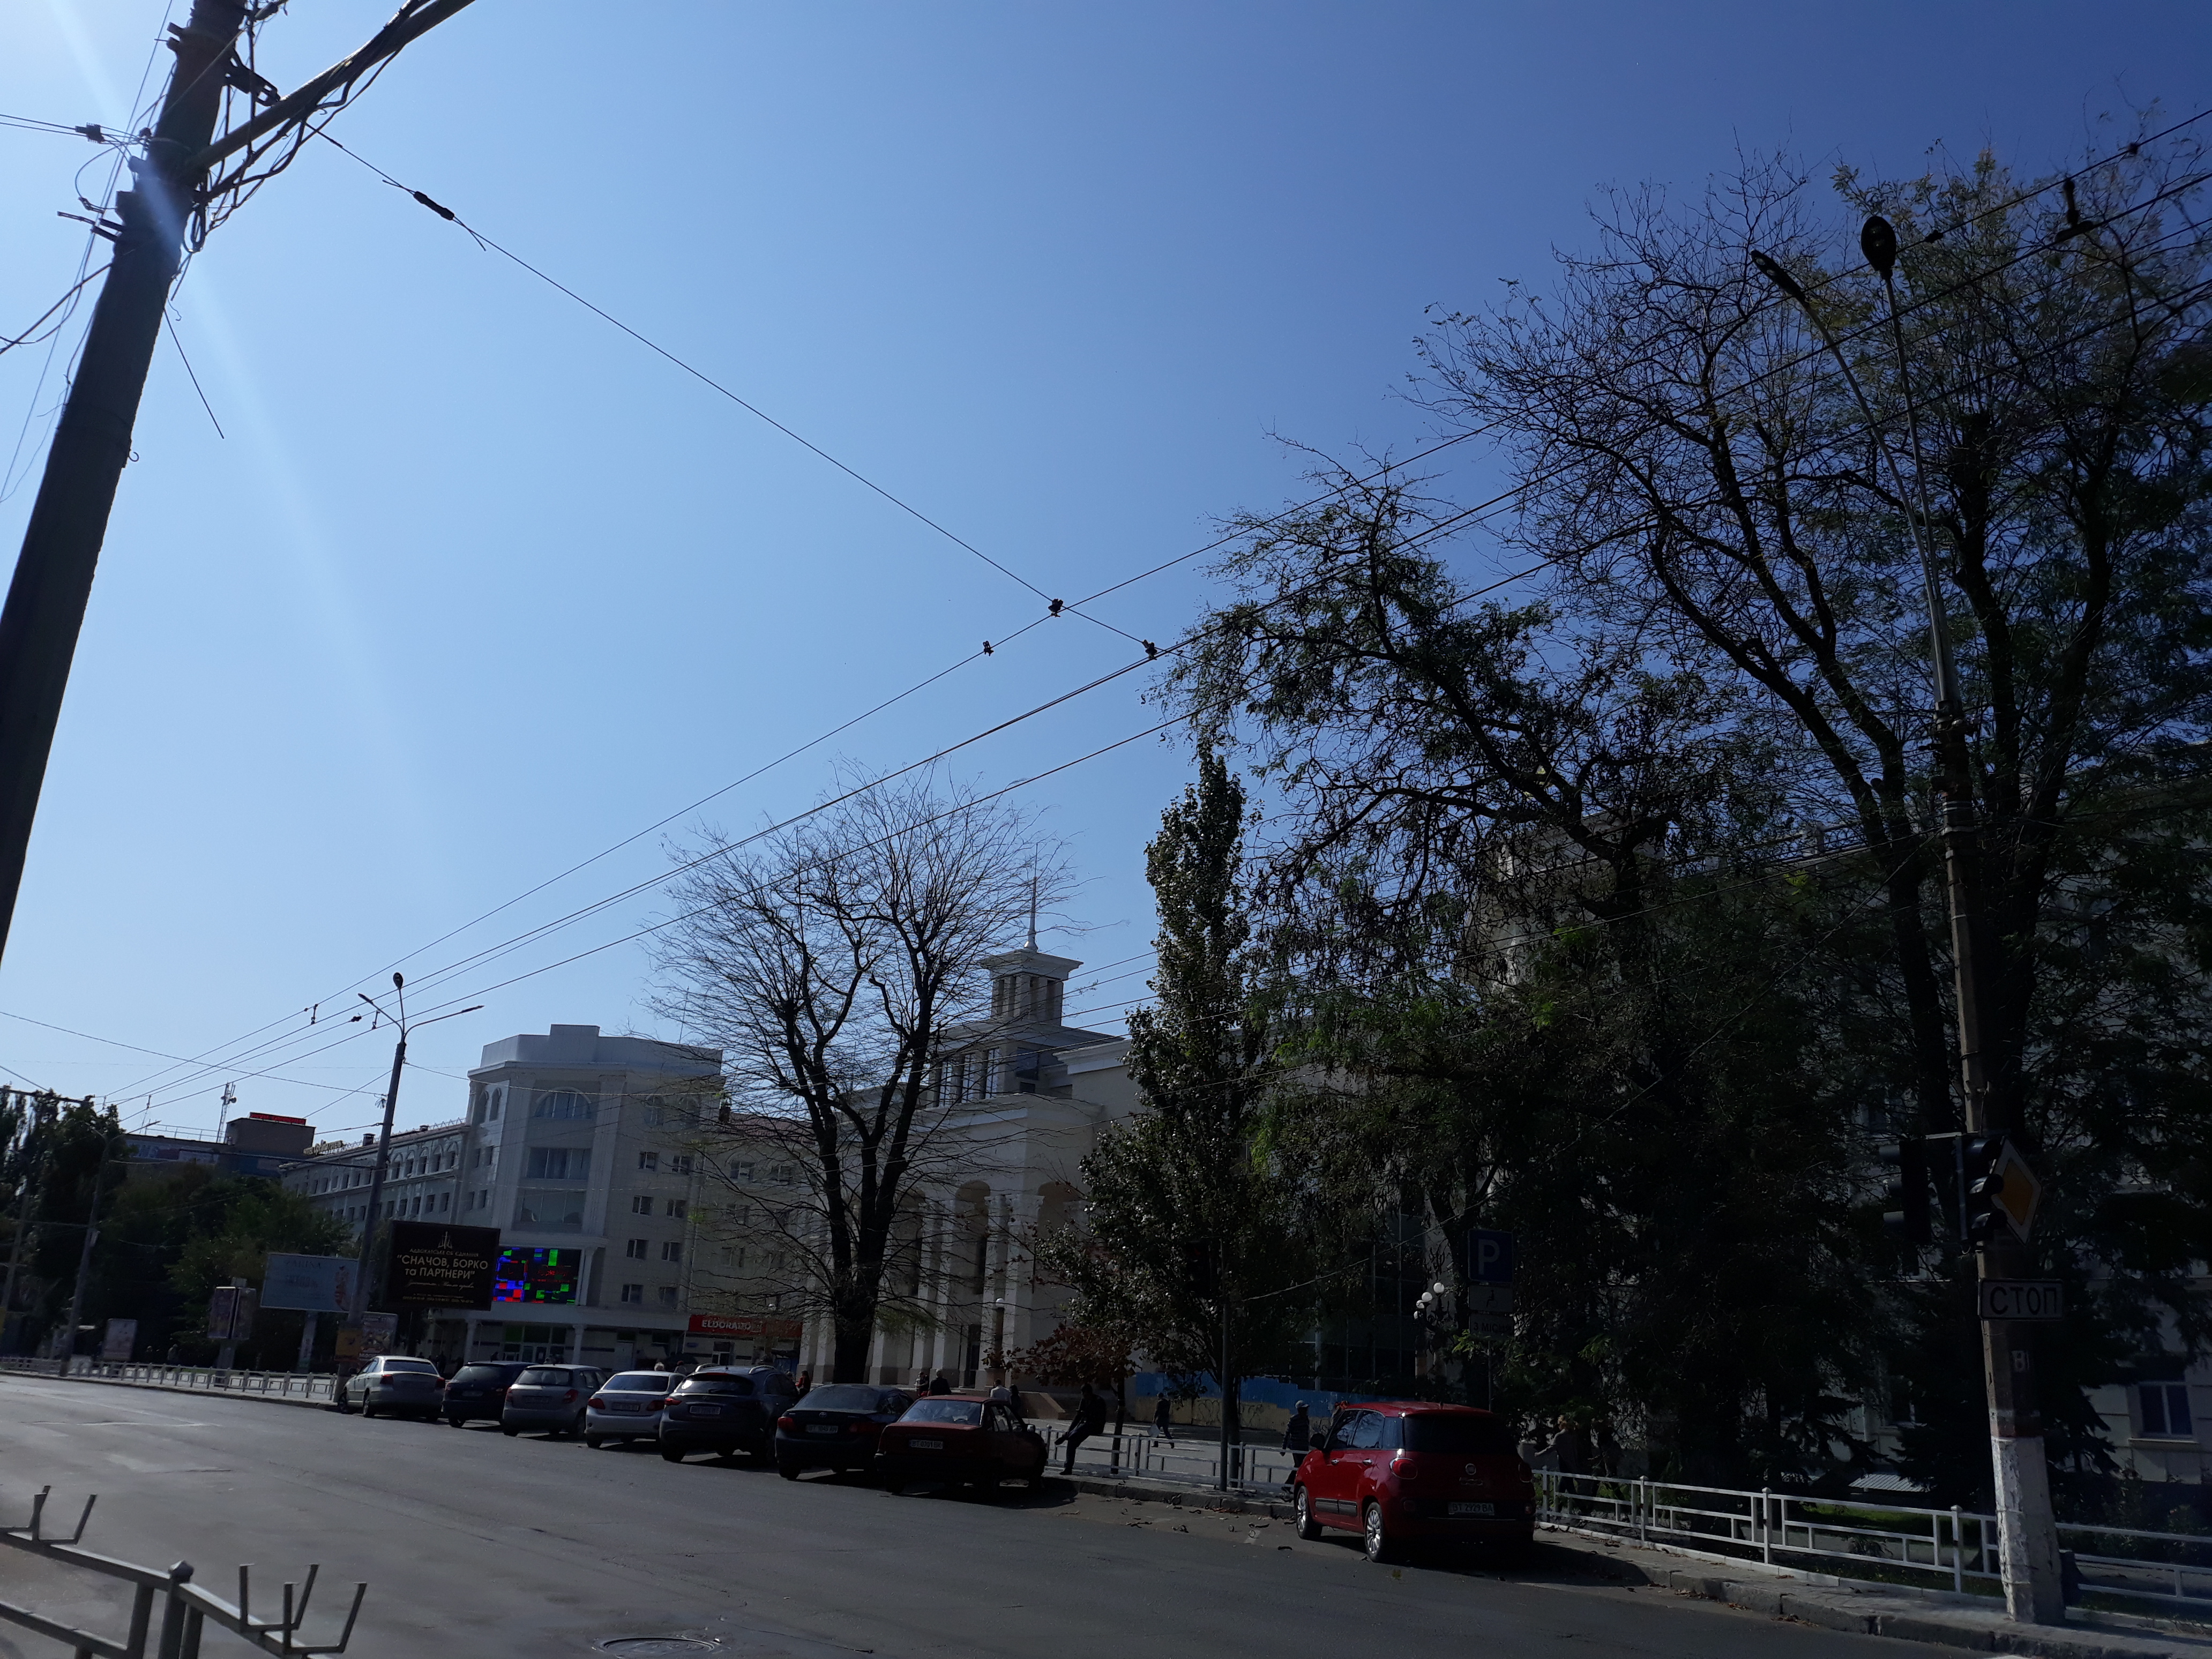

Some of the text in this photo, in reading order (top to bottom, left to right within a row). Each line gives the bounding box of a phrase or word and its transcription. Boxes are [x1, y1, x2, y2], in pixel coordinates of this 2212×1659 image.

[453, 1258, 489, 1270] БОРКО
[1477, 1238, 1500, 1275] P
[405, 1268, 417, 1276] та
[1990, 1286, 2057, 1315] СТОП
